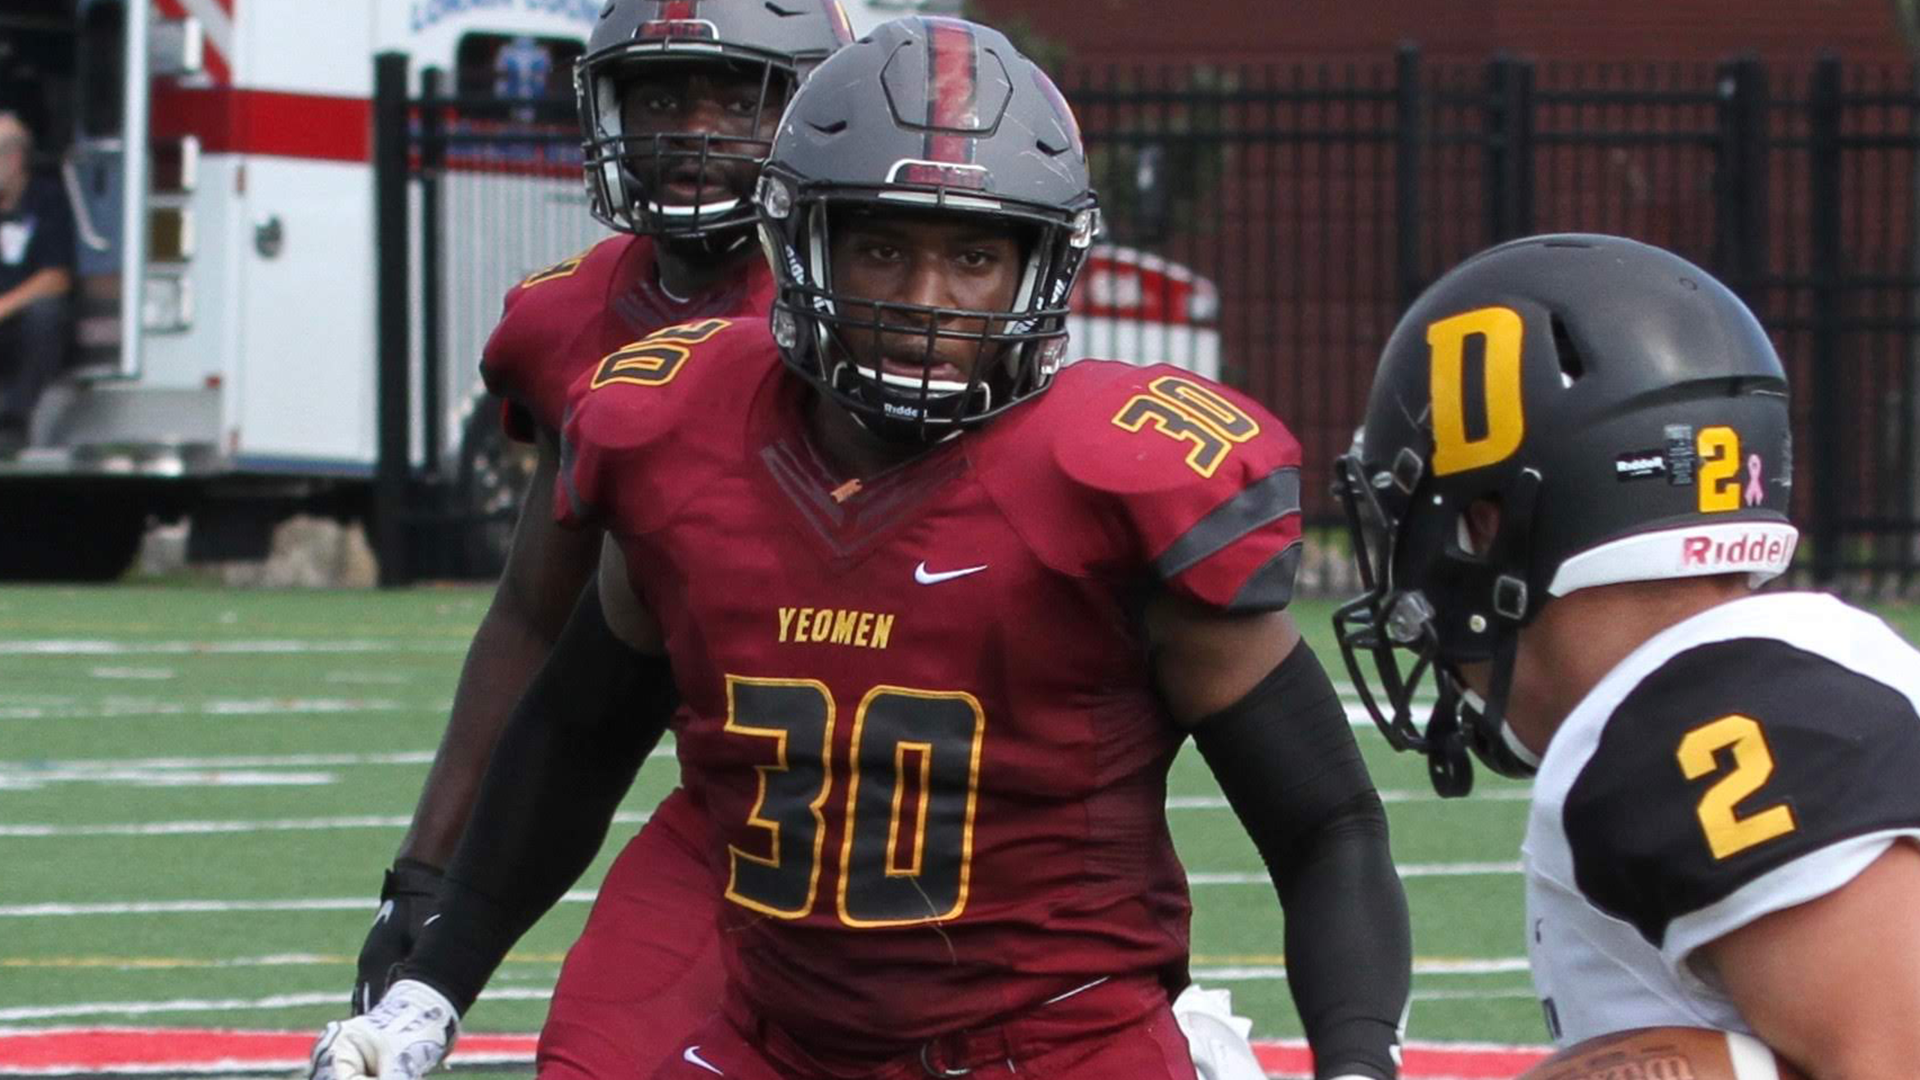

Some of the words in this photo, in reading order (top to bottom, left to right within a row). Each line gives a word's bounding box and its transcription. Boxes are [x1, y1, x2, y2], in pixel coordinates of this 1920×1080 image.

[1111, 376, 1260, 478] 30
[1427, 307, 1524, 476] D
[1697, 426, 1741, 513] 2
[778, 607, 895, 649] YEOMEN
[724, 673, 985, 928] 30
[1677, 715, 1795, 860] 2
